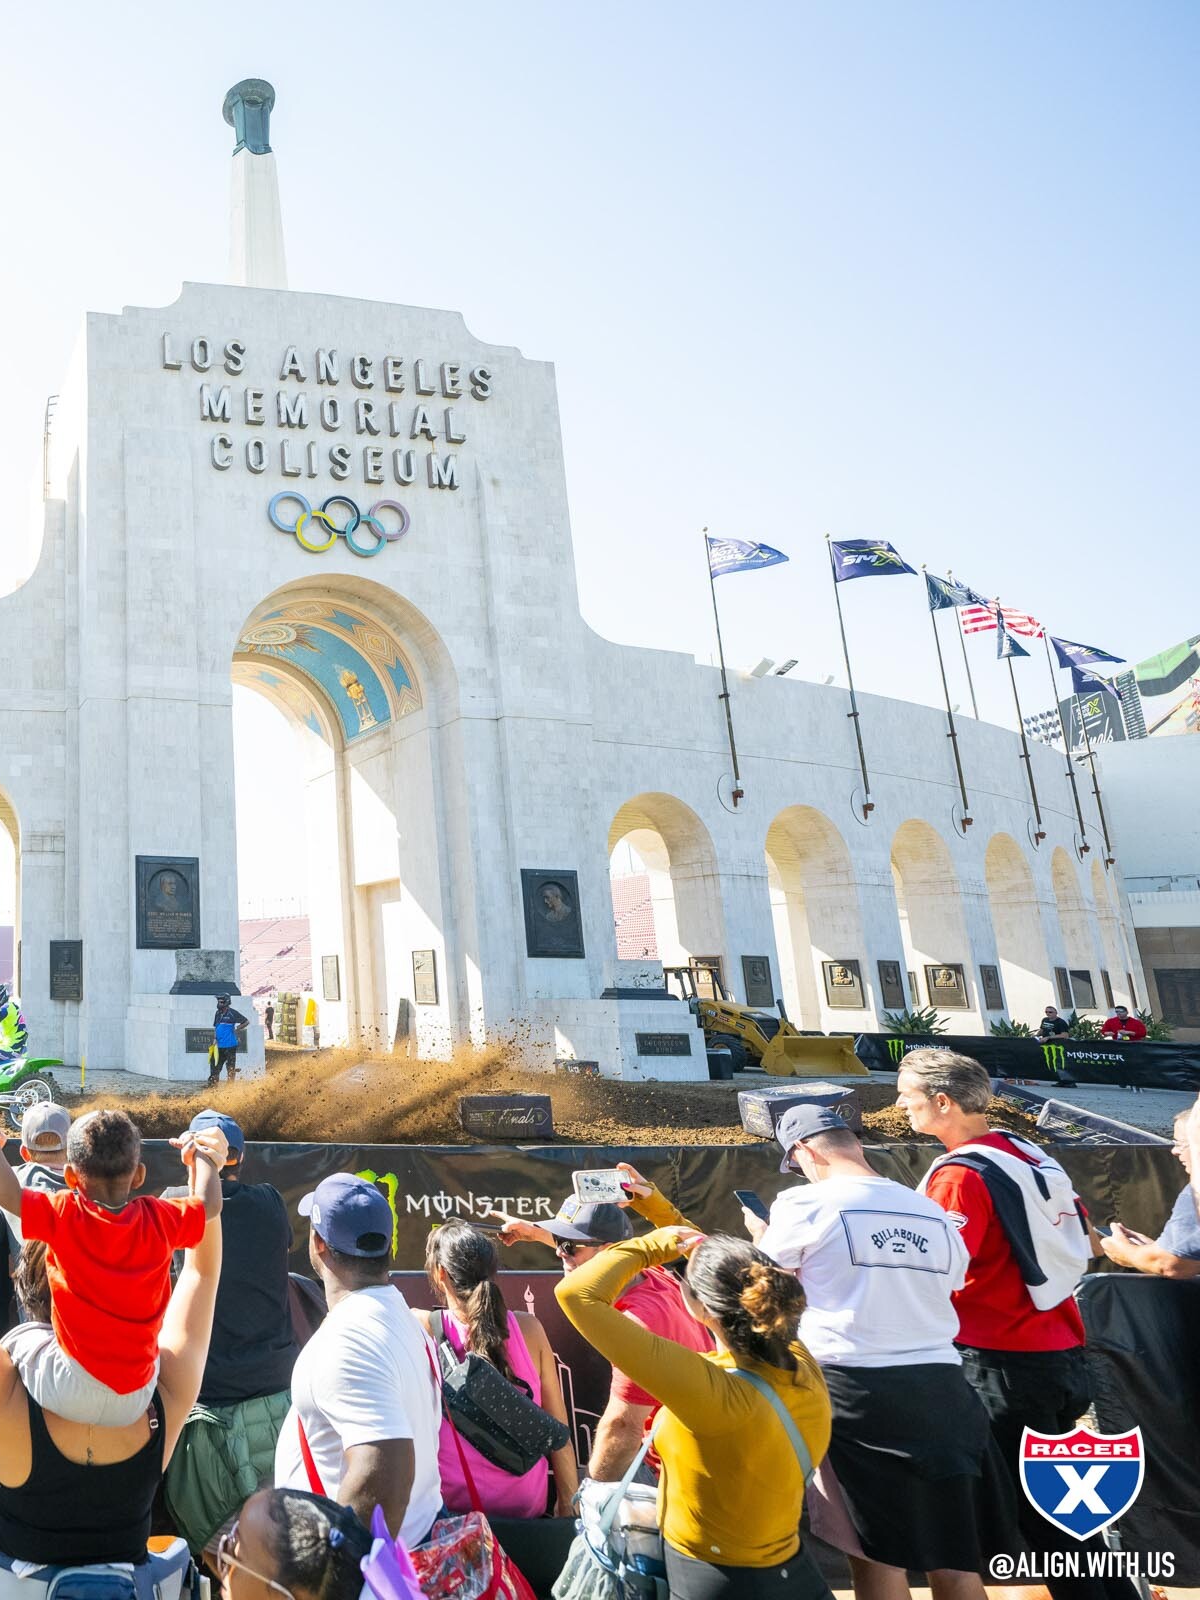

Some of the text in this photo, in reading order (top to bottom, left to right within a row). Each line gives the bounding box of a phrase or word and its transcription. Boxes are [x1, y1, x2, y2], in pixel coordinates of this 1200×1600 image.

[162, 331, 494, 401] LOS ANGELES
[200, 384, 467, 444] MEMORIAL
[210, 433, 460, 490] COLISEUM
[842, 547, 903, 567] SMX
[1066, 1050, 1125, 1062] MONSTER
[497, 1106, 536, 1127] Finals
[405, 1190, 555, 1219] MONSTER
[871, 1228, 929, 1253] BILLABONG
